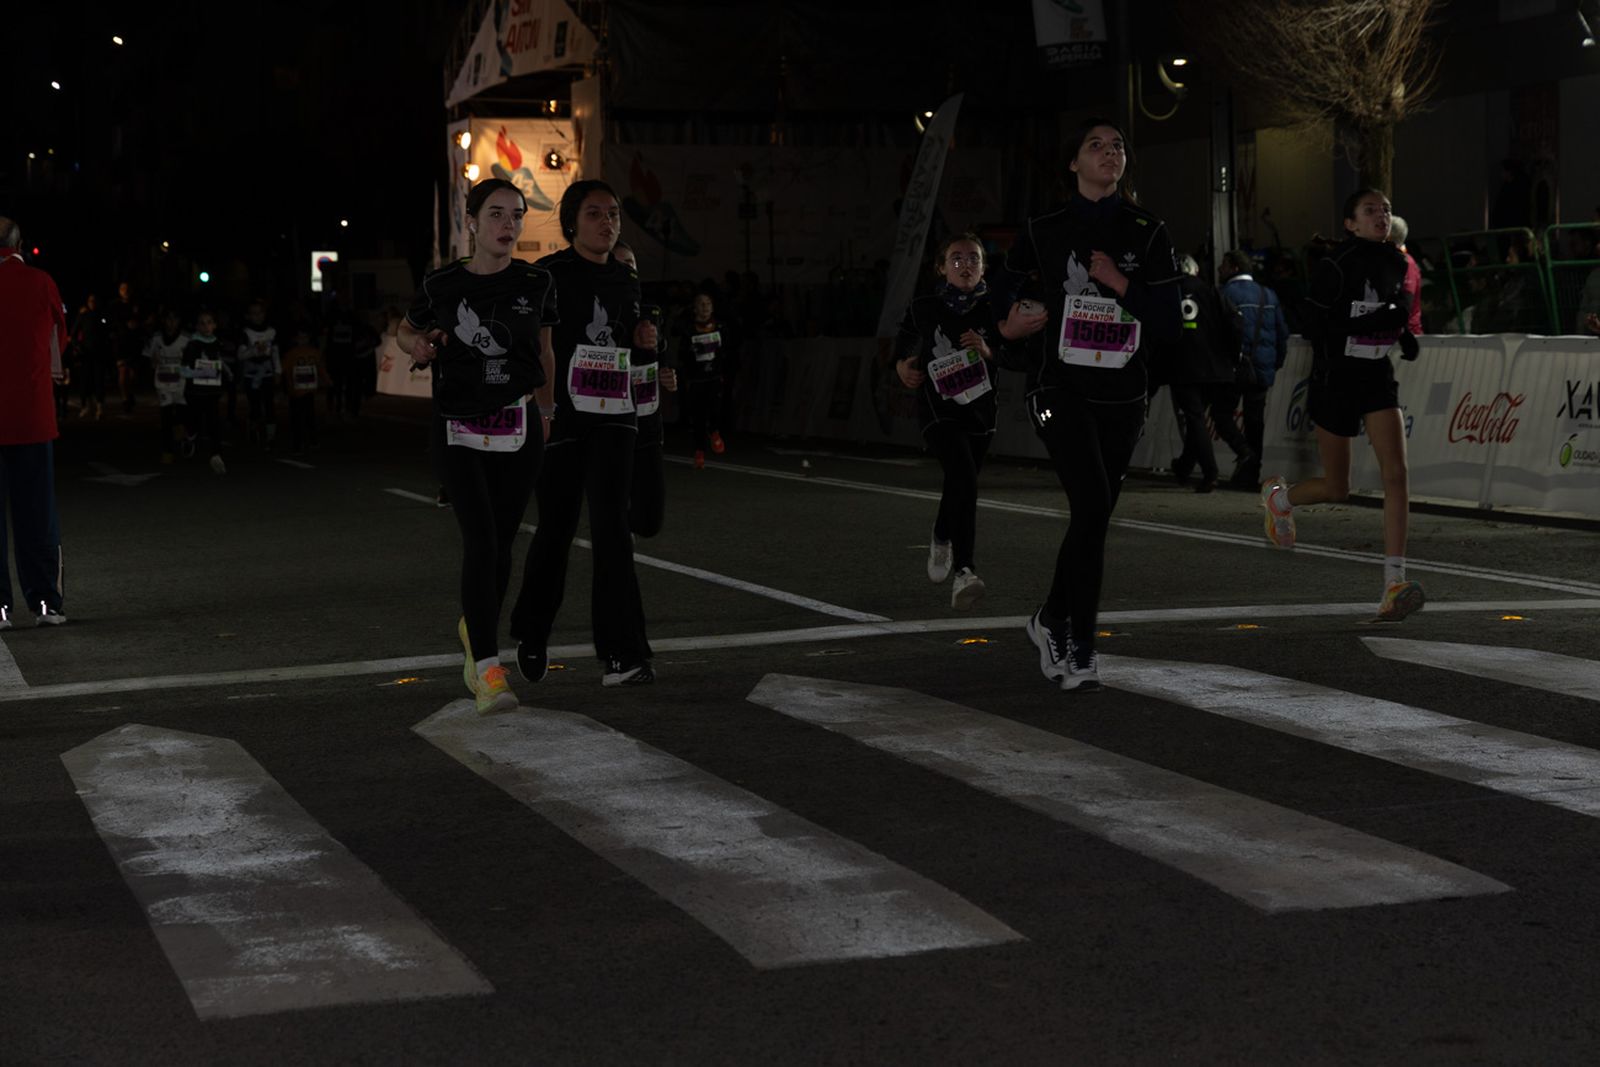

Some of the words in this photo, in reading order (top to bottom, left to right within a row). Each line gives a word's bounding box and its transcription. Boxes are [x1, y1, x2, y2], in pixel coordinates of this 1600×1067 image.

[1083, 304, 1105, 312] NOCHE
[1072, 311, 1088, 319] SAN
[1072, 320, 1131, 344] 15659
